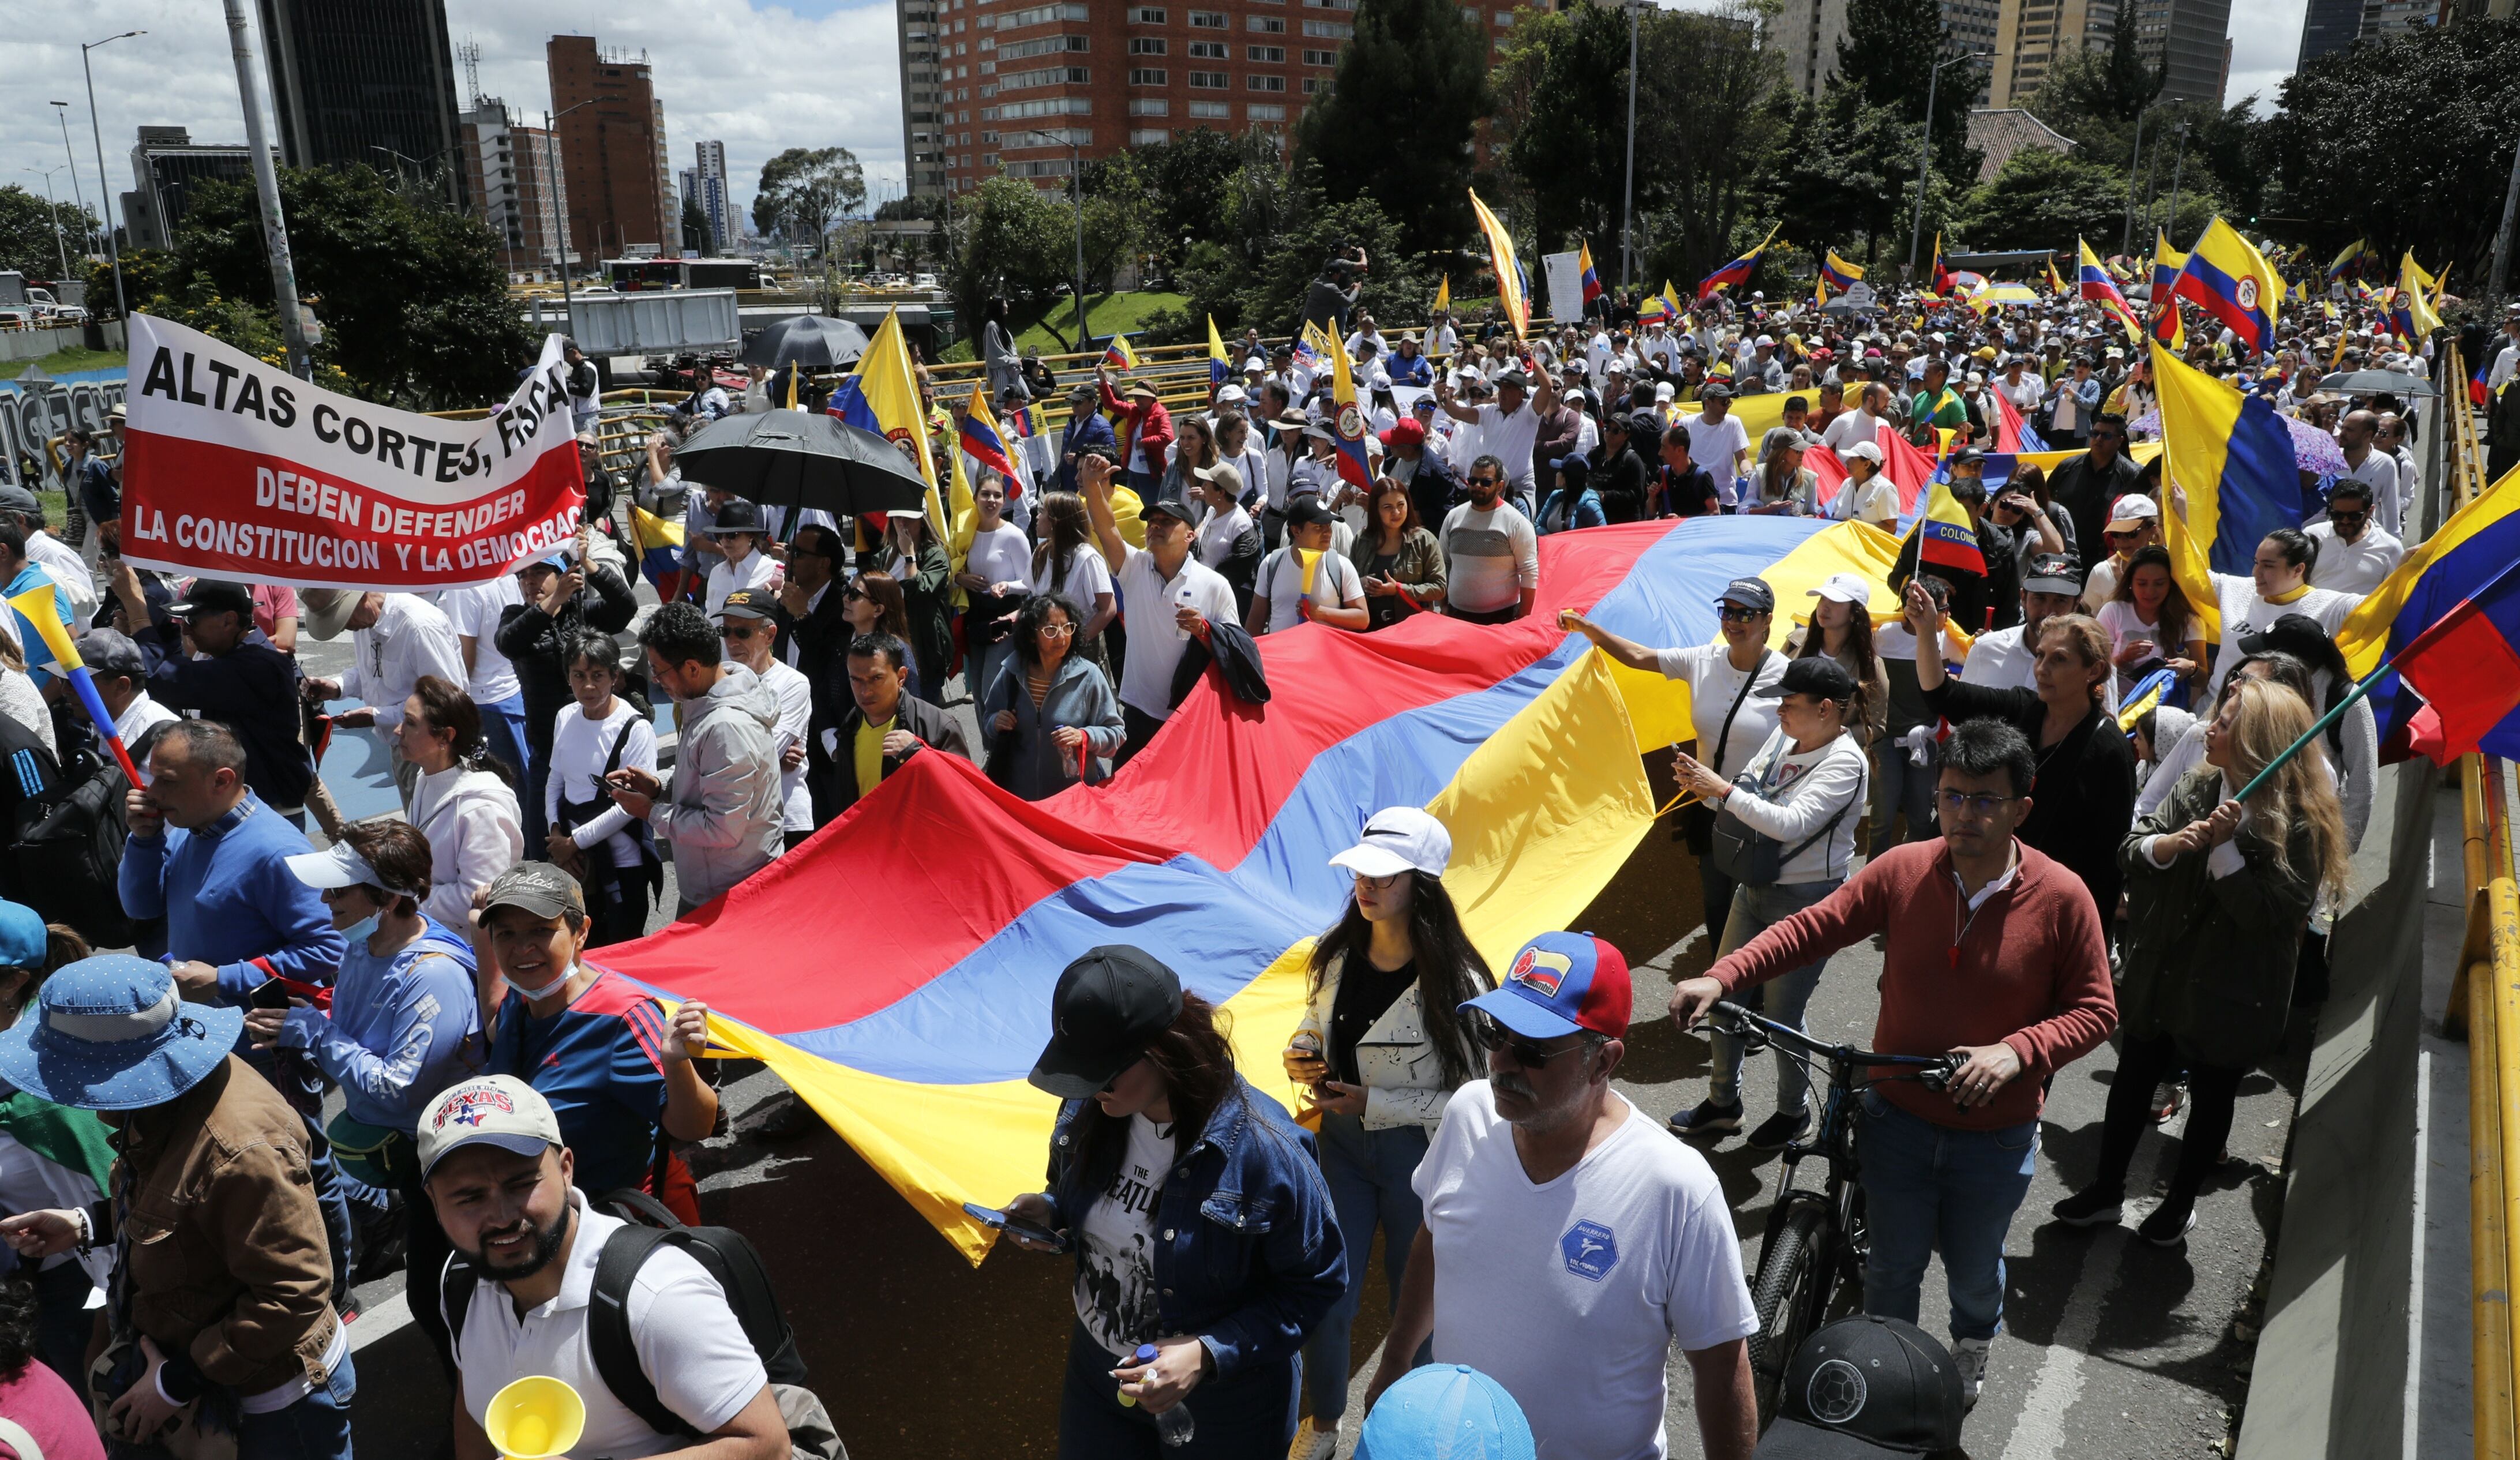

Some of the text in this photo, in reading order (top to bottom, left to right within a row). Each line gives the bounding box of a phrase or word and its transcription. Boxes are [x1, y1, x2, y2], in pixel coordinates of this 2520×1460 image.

[142, 346, 570, 482] ALTAS CORTES, FISCA
[256, 467, 526, 538] DEBEN DEFENDER
[134, 505, 582, 571] LA CONSTITUCION Y LA DEMOCRAC
[1940, 526, 1979, 547] COLOMB
[1523, 974, 1554, 996] Colombia
[433, 1089, 513, 1132] TEXAS
[1134, 1165, 1149, 1180] THE
[1107, 1173, 1151, 1214] EATL
[1578, 1225, 1610, 1240] GUERRERO
